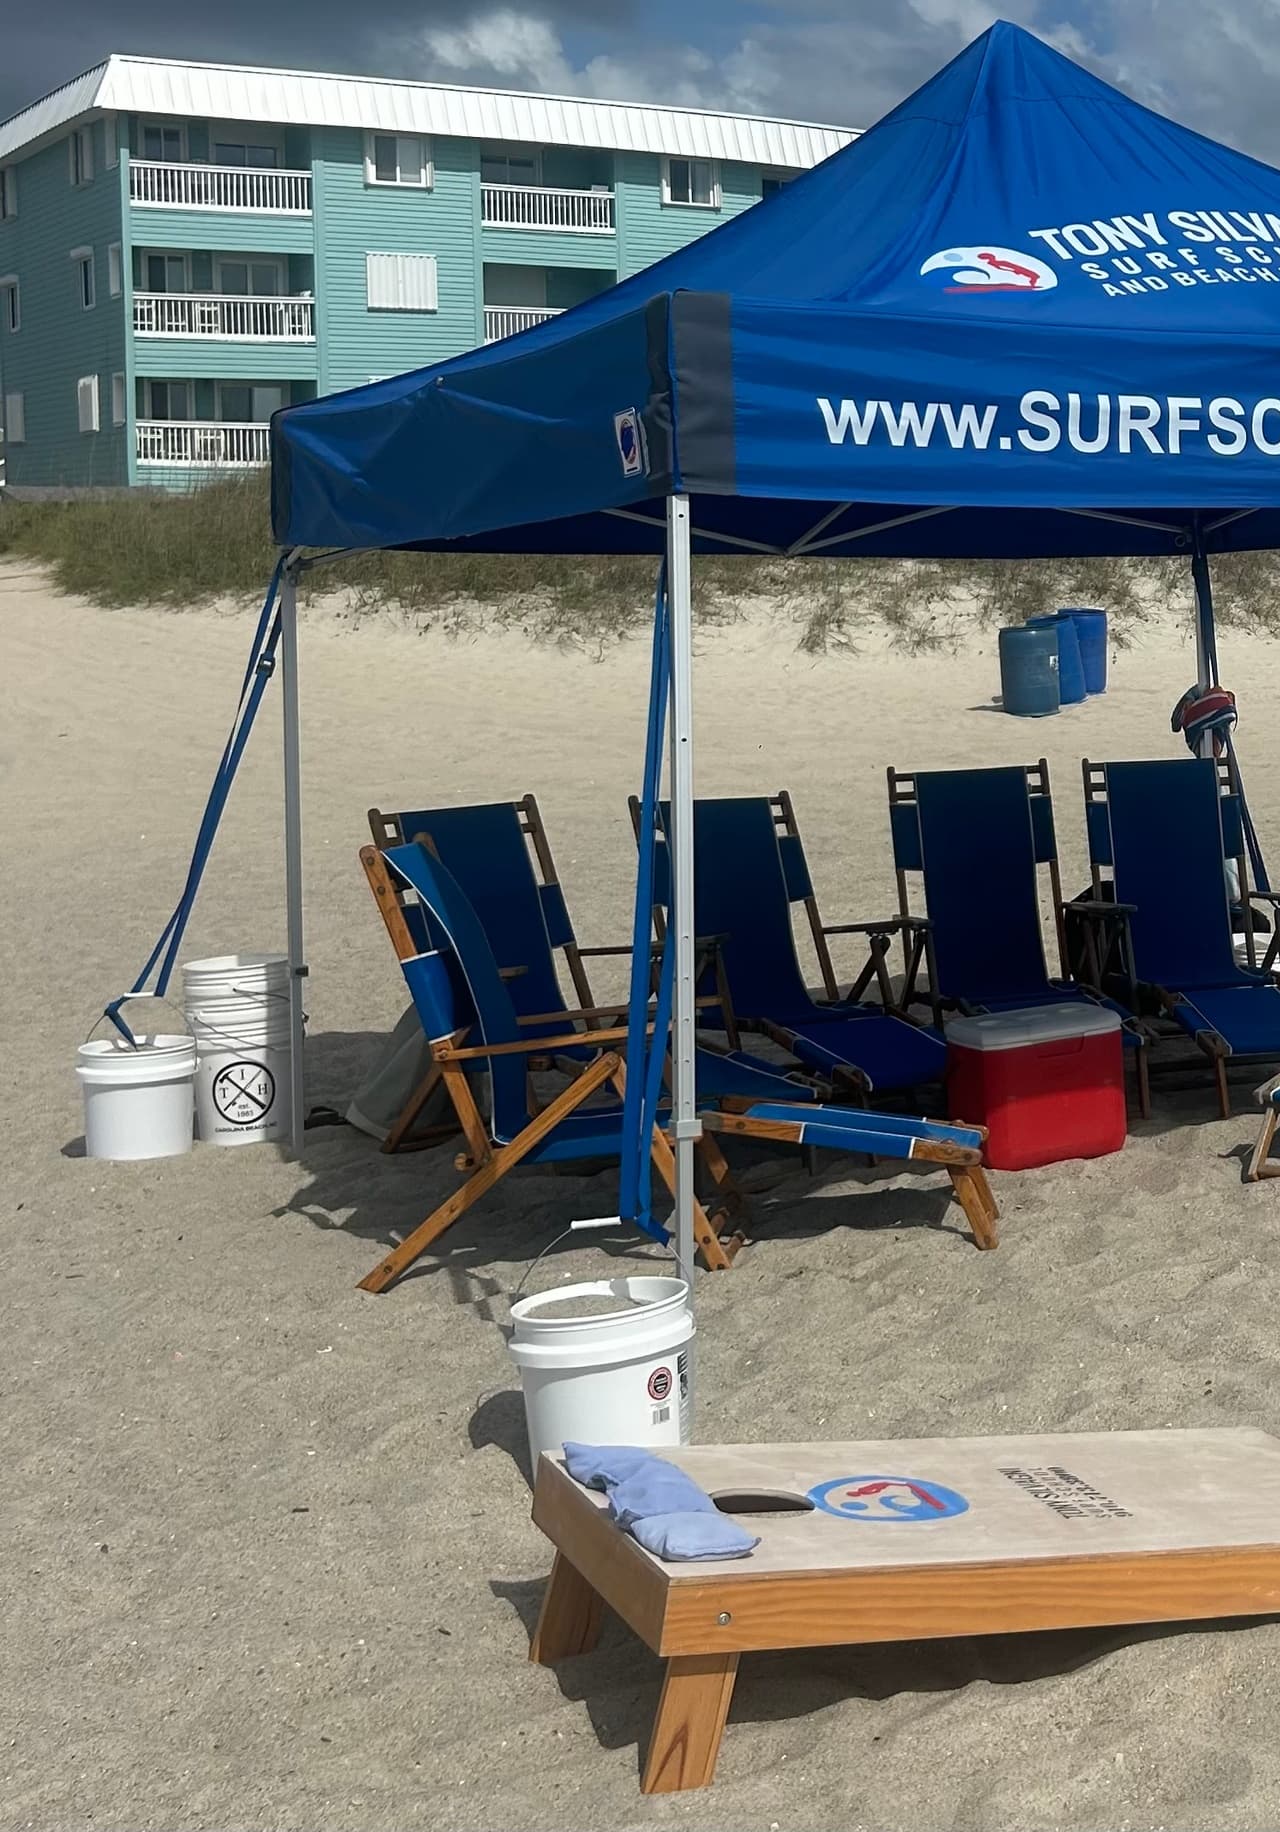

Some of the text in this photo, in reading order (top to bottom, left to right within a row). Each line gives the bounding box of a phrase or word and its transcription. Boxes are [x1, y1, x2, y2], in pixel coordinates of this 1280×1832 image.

[1029, 214, 1164, 261] TONY
[1083, 250, 1200, 281] SURF
[1102, 273, 1170, 298] AND
[1178, 268, 1275, 288] BEACH
